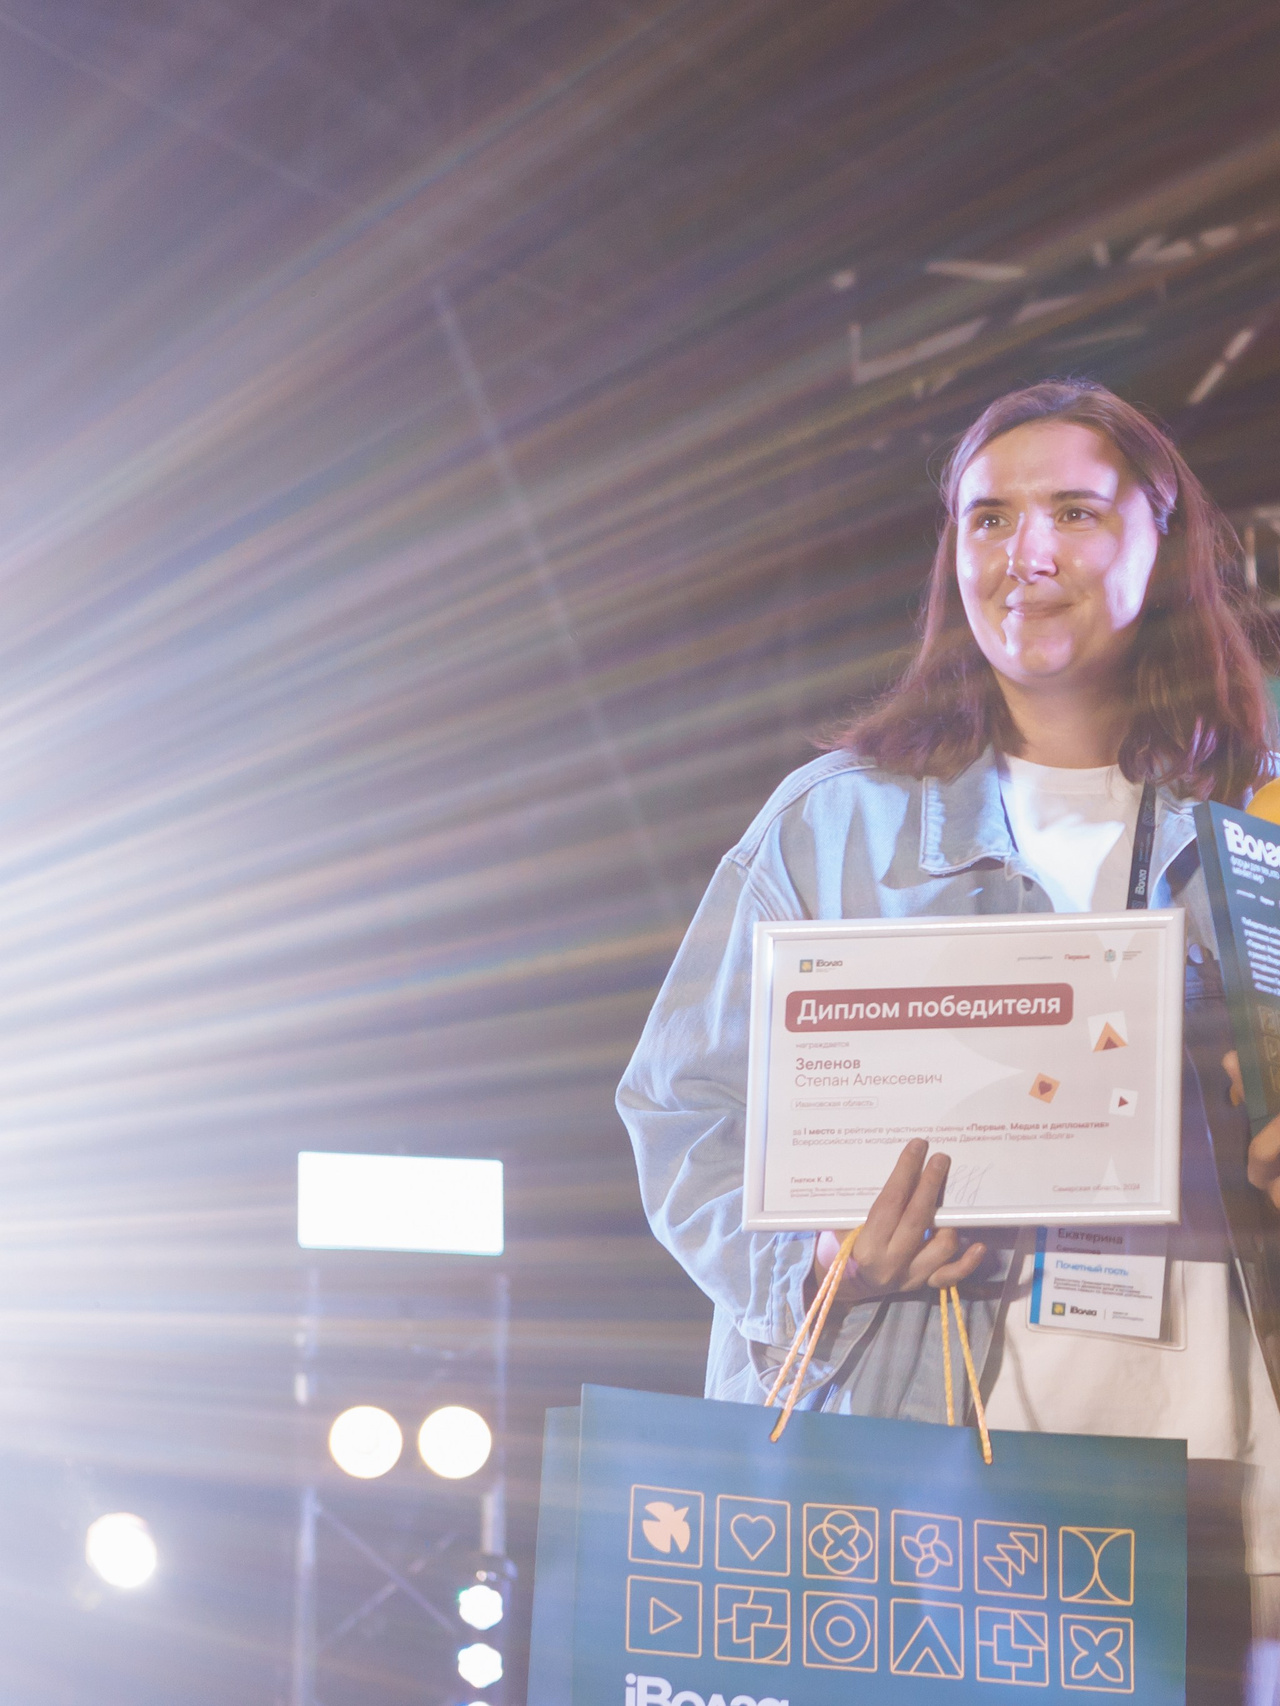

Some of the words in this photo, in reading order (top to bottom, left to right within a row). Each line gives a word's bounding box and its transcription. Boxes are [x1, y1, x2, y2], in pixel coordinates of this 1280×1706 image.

[796, 999, 900, 1025] Диплом
[907, 994, 1061, 1020] победителя
[795, 1058, 861, 1071] Зеленов
[795, 1074, 849, 1087] Степан
[853, 1073, 943, 1086] Алексеевич
[843, 1099, 874, 1107] область
[844, 1126, 884, 1136] рейтинге
[886, 1125, 933, 1135] участников
[1057, 1228, 1124, 1245] Екатерина
[1104, 1267, 1129, 1276] гость
